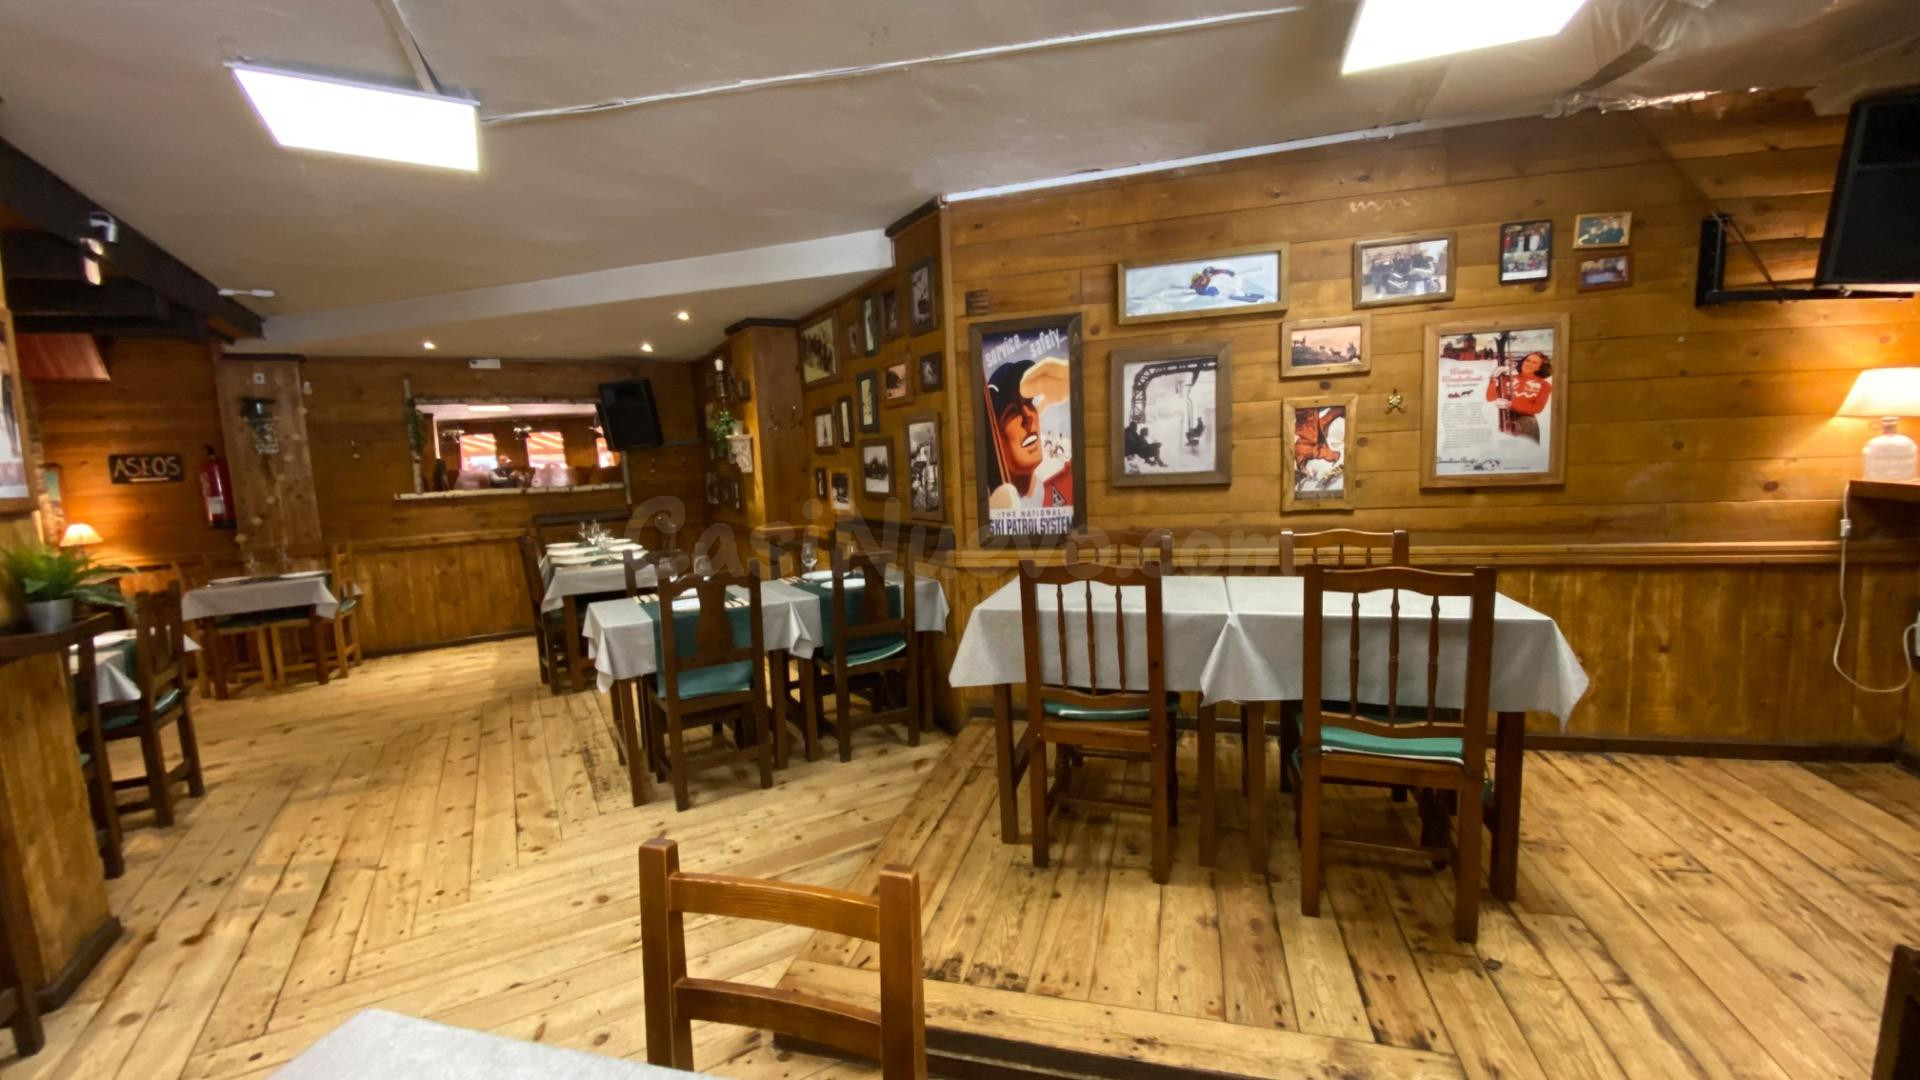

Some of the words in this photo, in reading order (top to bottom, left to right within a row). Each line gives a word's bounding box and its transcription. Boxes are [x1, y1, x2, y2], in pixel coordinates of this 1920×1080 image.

[113, 456, 181, 478] ASEOS
[1021, 509, 1062, 518] NATIONAL
[990, 519, 1004, 535] SKI
[1007, 518, 1039, 535] PATROL
[1040, 516, 1074, 535] SYSTEM
